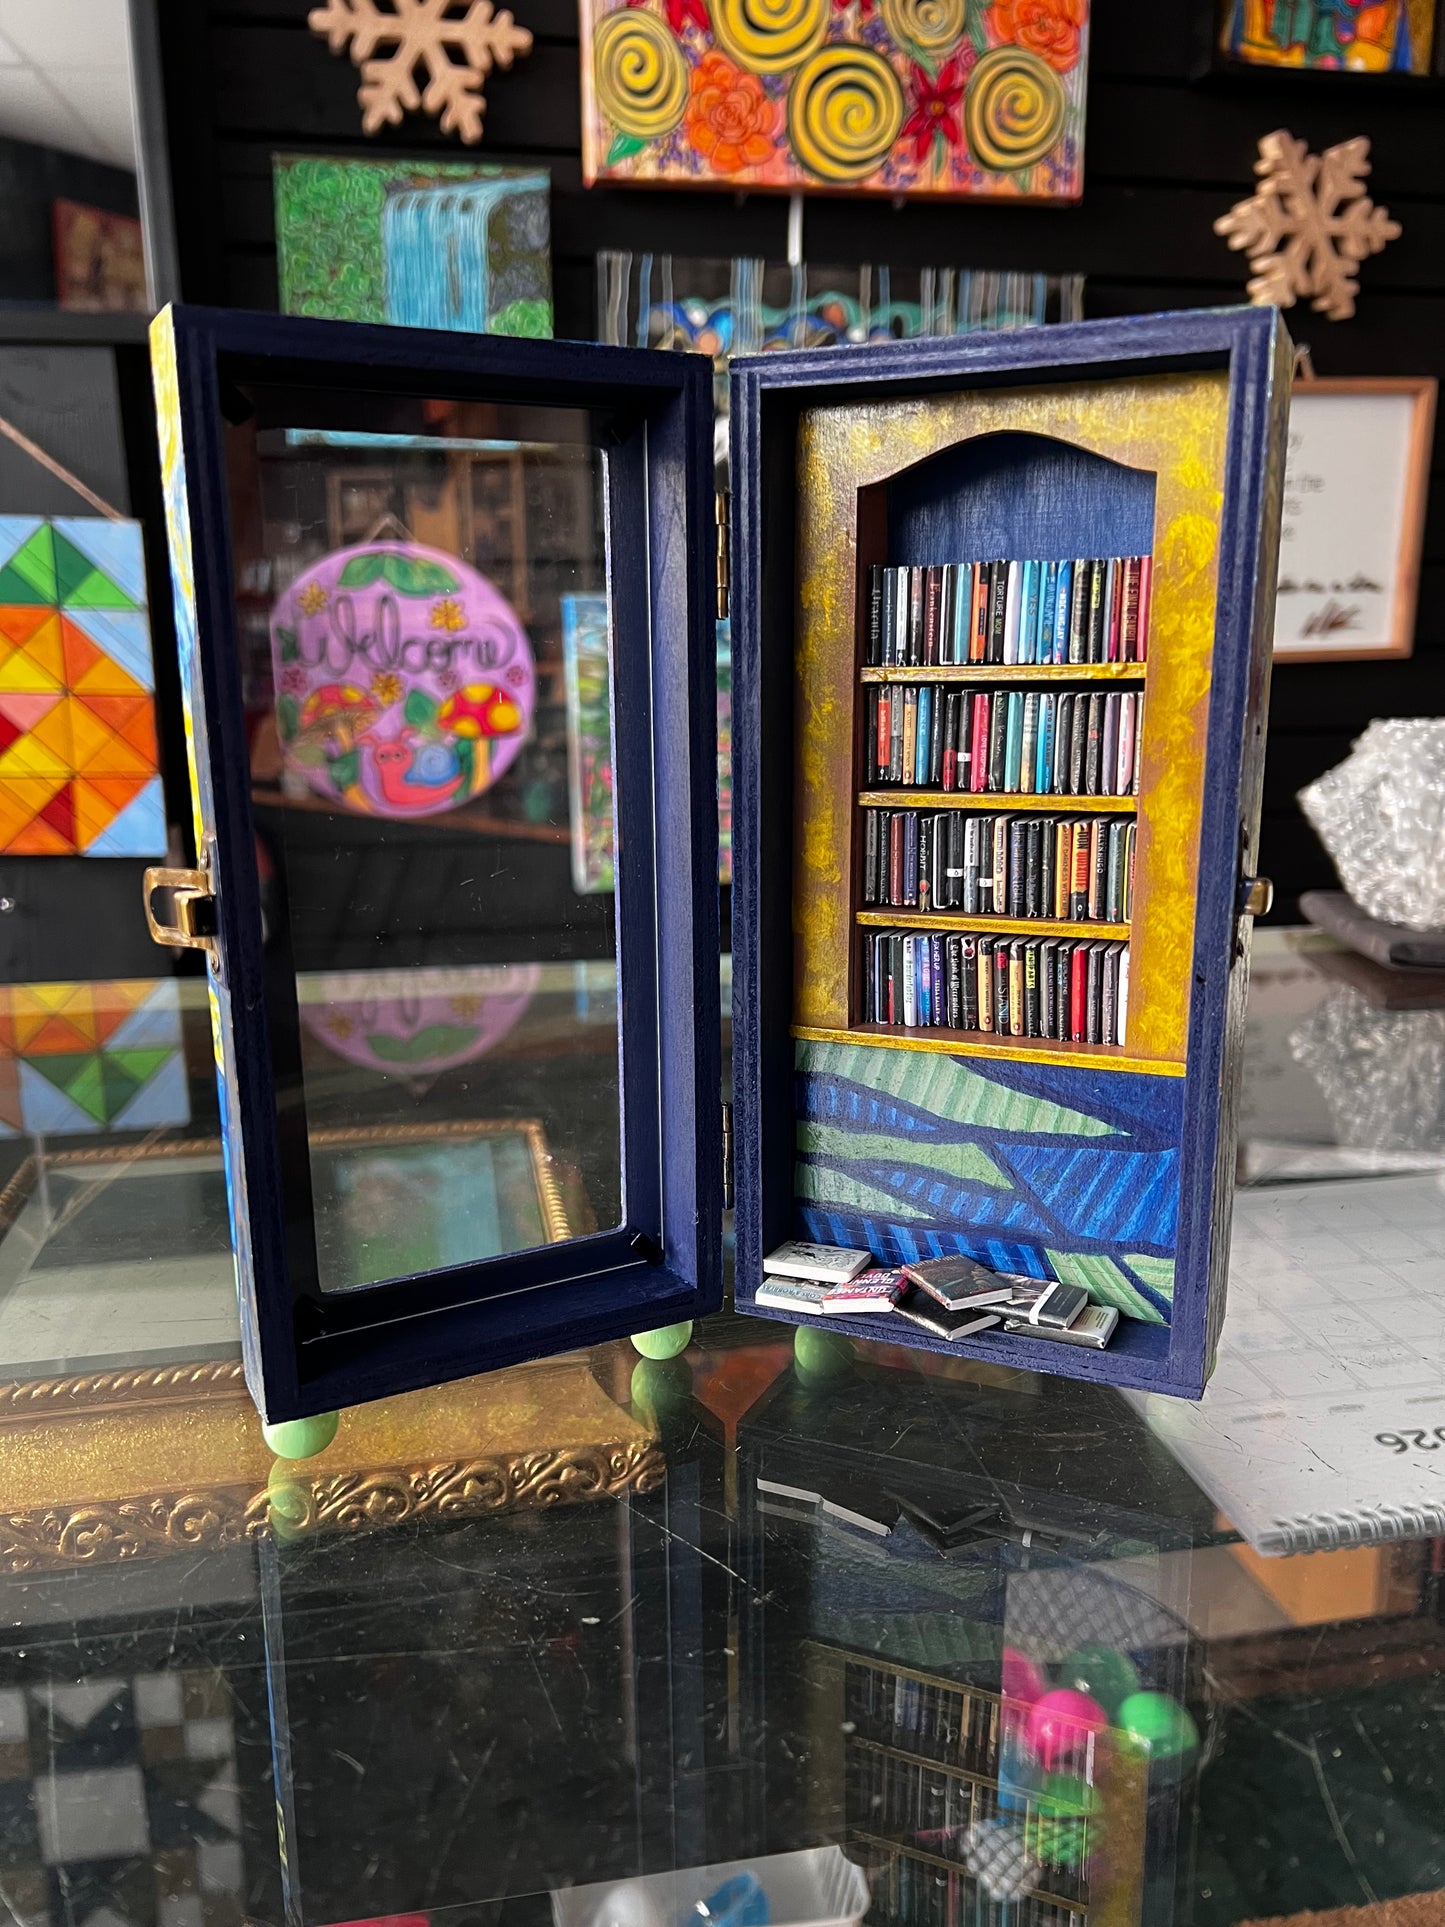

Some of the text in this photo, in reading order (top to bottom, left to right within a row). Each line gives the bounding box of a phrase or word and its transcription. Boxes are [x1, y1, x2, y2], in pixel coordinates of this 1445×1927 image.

[871, 589, 881, 640] Dracula
[928, 582, 941, 647] Frankenstein
[994, 580, 1005, 635] TORTURE MOM
[1029, 593, 1038, 617] YES
[1057, 592, 1067, 640] MOCKINGJAY
[296, 594, 519, 677] Welcome
[919, 835, 927, 871] HOBBIT
[1076, 831, 1089, 888] DON QUIXOTE
[1096, 824, 1106, 874] EVELYN HUGO
[998, 986, 1009, 1024] STAND
[827, 1284, 888, 1296] UNTAMED
